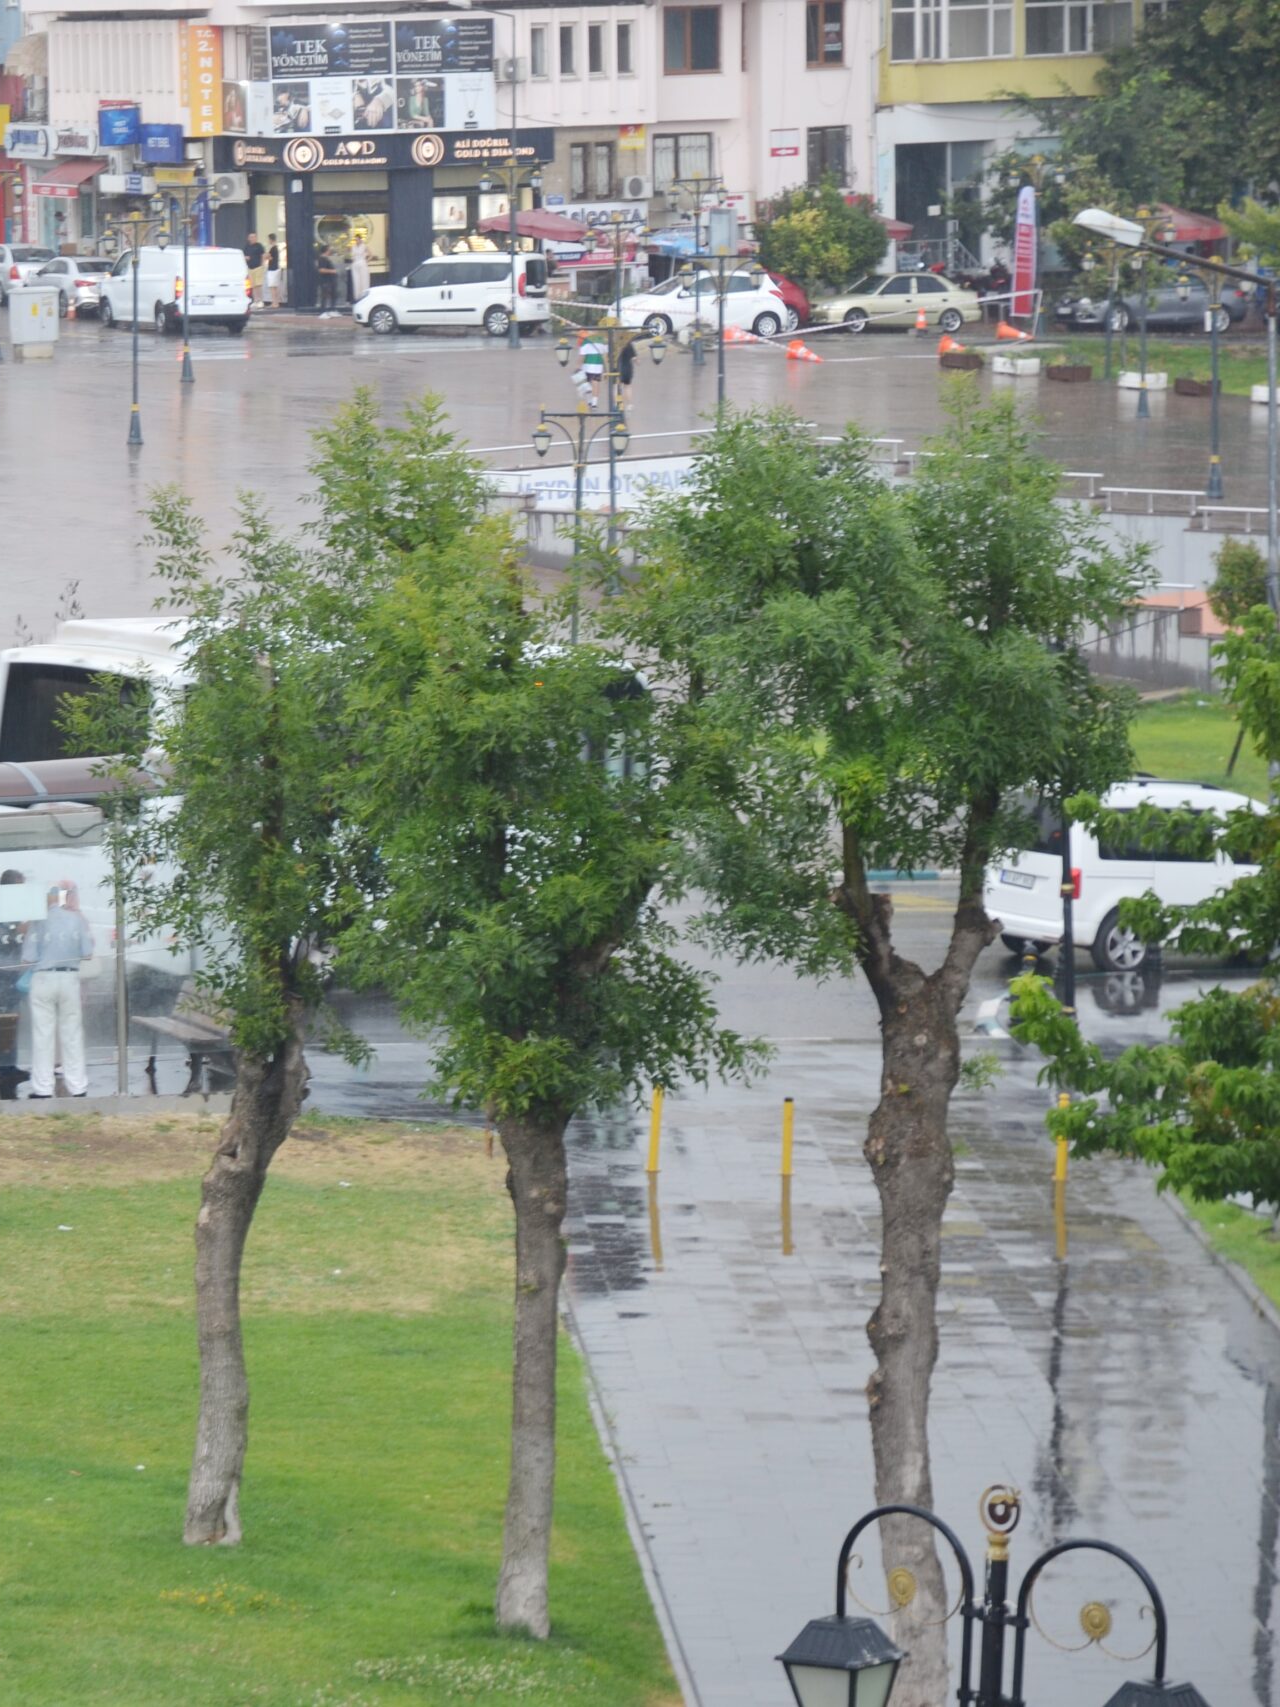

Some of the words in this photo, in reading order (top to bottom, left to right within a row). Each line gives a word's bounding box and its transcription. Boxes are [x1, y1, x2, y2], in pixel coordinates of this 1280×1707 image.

[292, 39, 328, 54] TEK
[413, 35, 441, 49] TEK
[272, 53, 329, 67] YÖNETİM
[396, 49, 443, 62] YÖNETİM
[199, 57, 215, 132] NOTER
[454, 138, 471, 149] ALİ
[472, 137, 510, 148] DOĞRUL
[454, 148, 481, 158] GOLD
